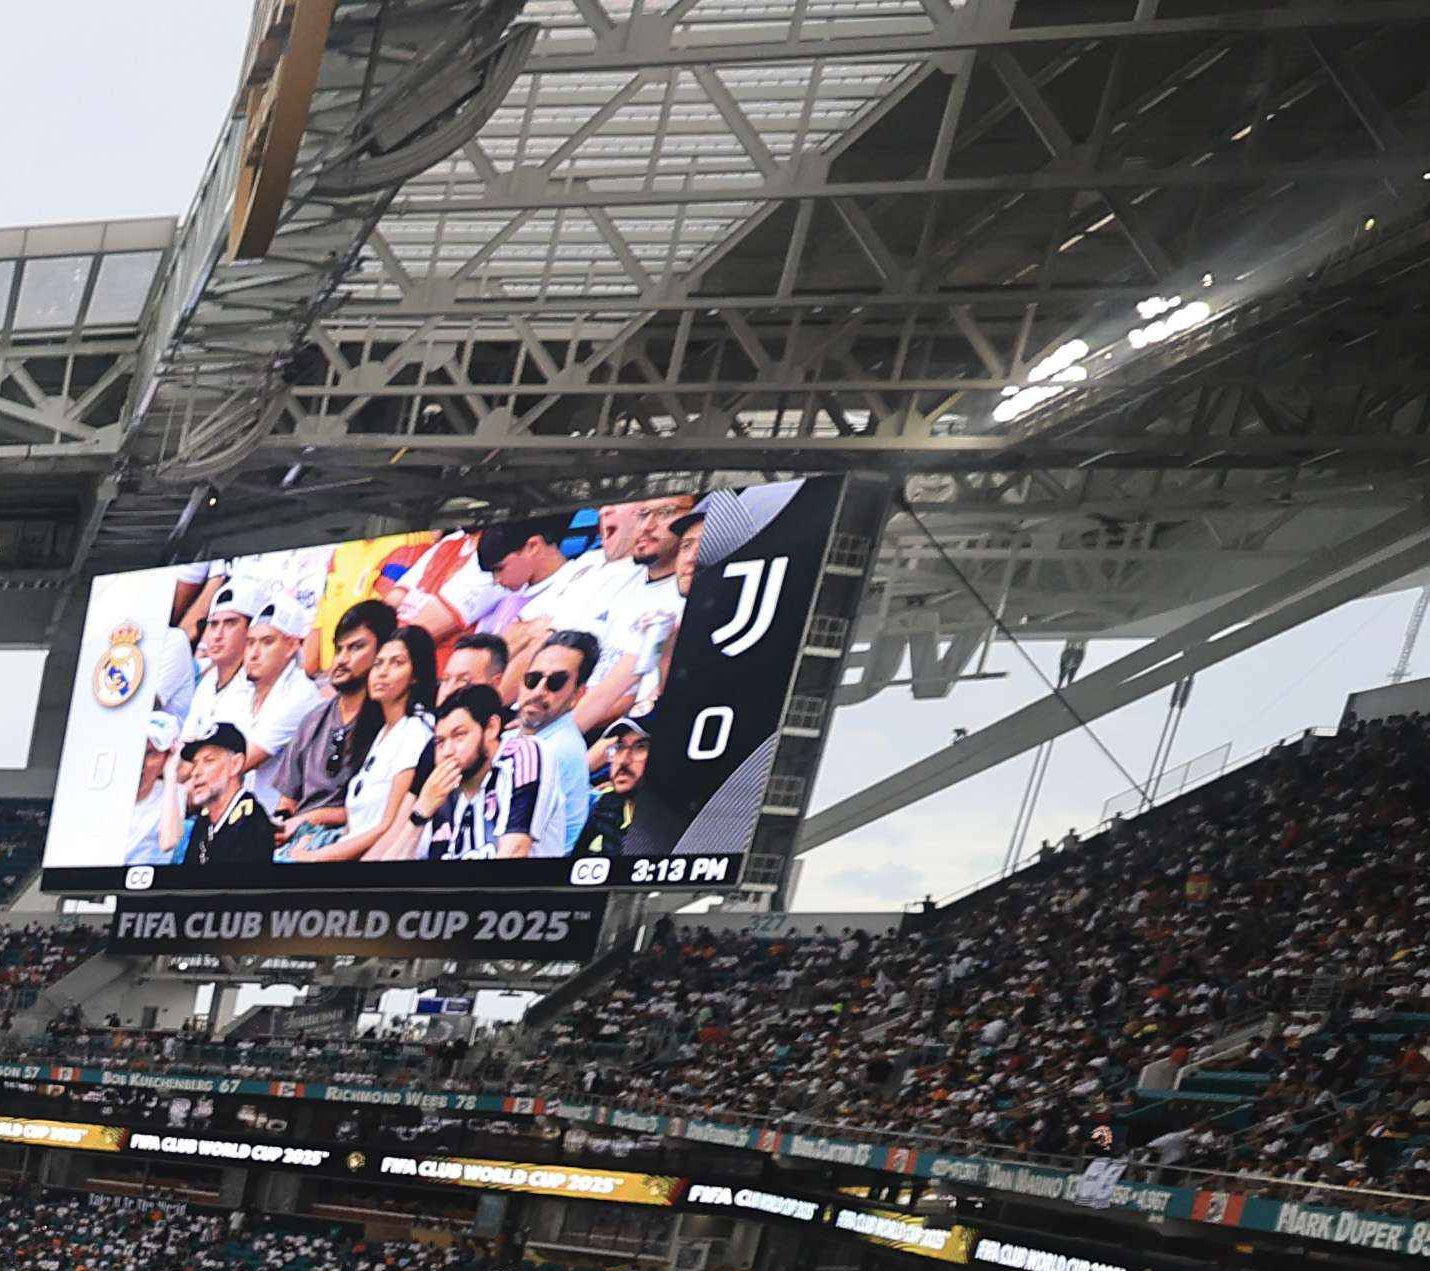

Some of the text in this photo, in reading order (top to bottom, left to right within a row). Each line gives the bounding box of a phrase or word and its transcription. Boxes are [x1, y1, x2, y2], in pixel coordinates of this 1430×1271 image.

[688, 705, 734, 760] 0
[577, 863, 603, 881] CC
[631, 857, 730, 882] 3:13 PM
[118, 912, 179, 939] FIFA
[183, 911, 264, 939] CLUB
[270, 909, 389, 939] WORLD
[396, 909, 470, 939] CUP
[24, 1066, 41, 1079] 57
[456, 1095, 477, 1110] 78
